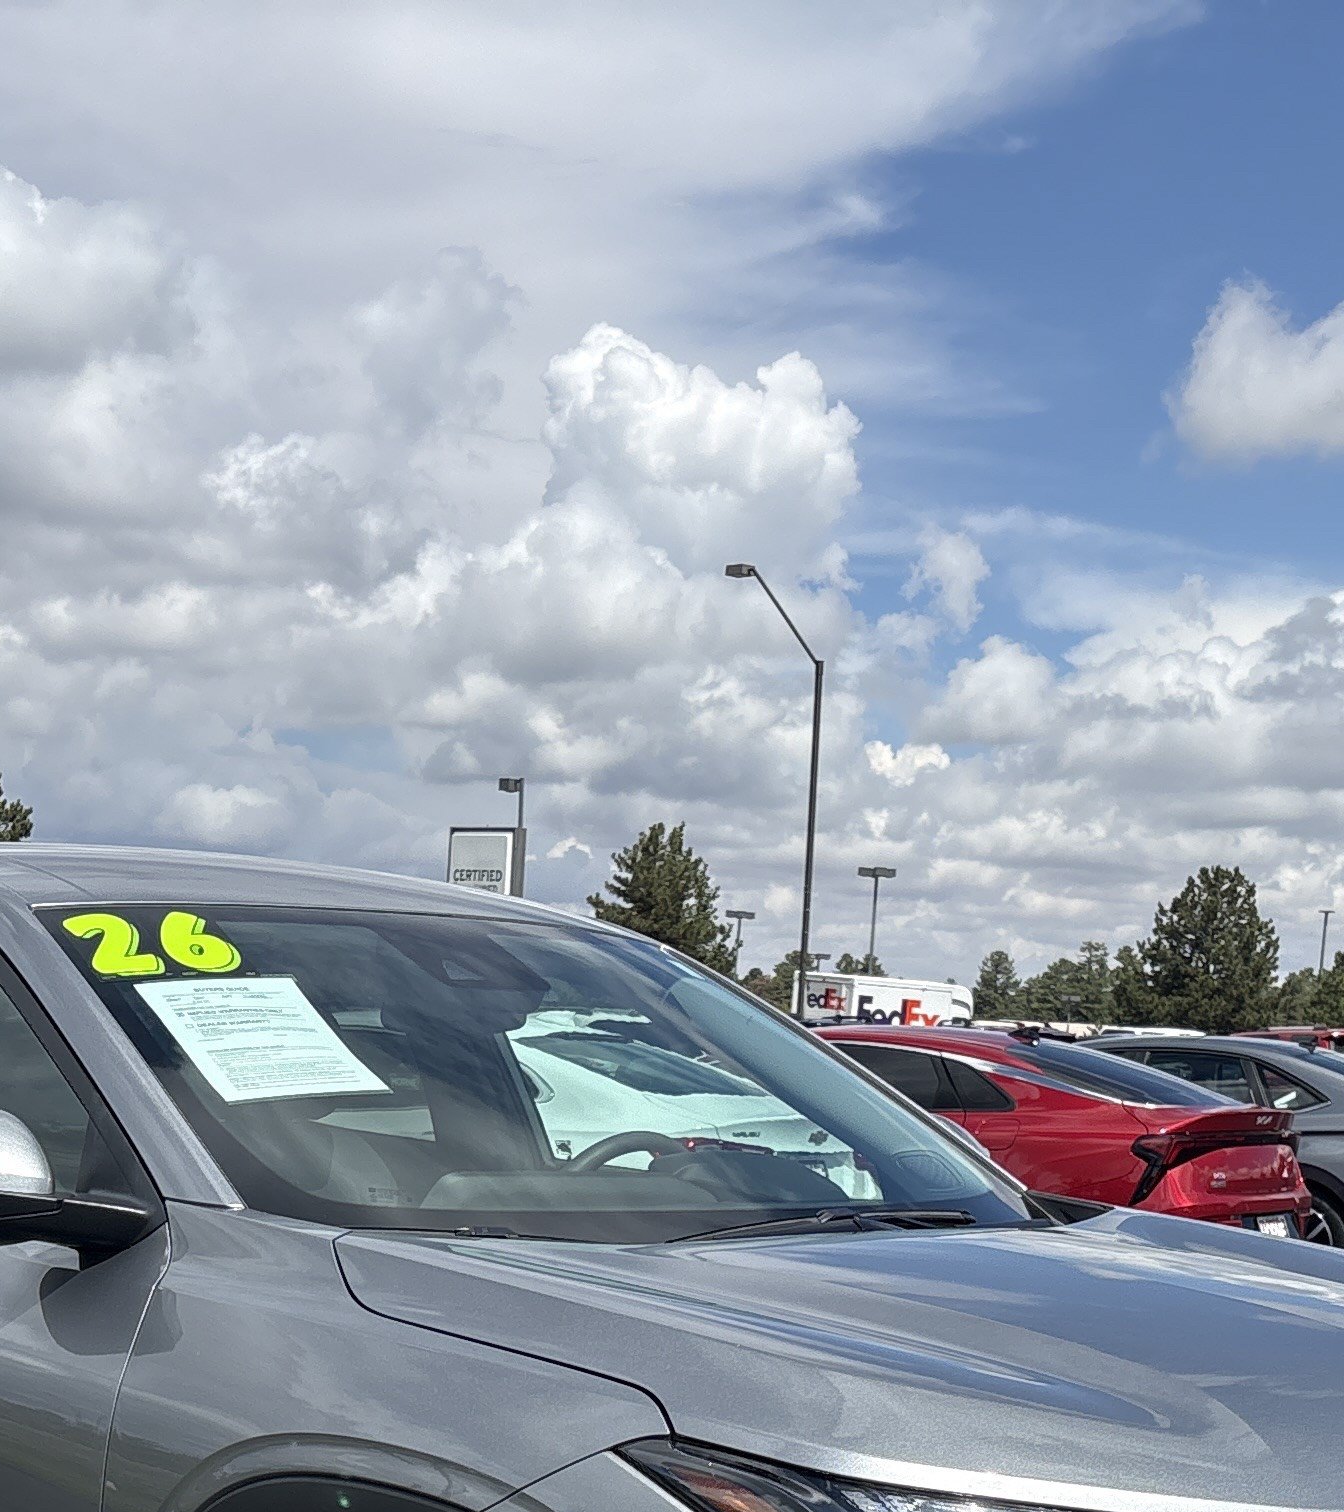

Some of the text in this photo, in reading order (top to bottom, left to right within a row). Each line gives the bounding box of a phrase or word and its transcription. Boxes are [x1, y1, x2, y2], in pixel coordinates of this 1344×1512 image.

[453, 868, 503, 882] CERTIFIED
[62, 911, 241, 976] 26
[807, 987, 847, 1011] edEx
[858, 995, 941, 1027] FedEx
